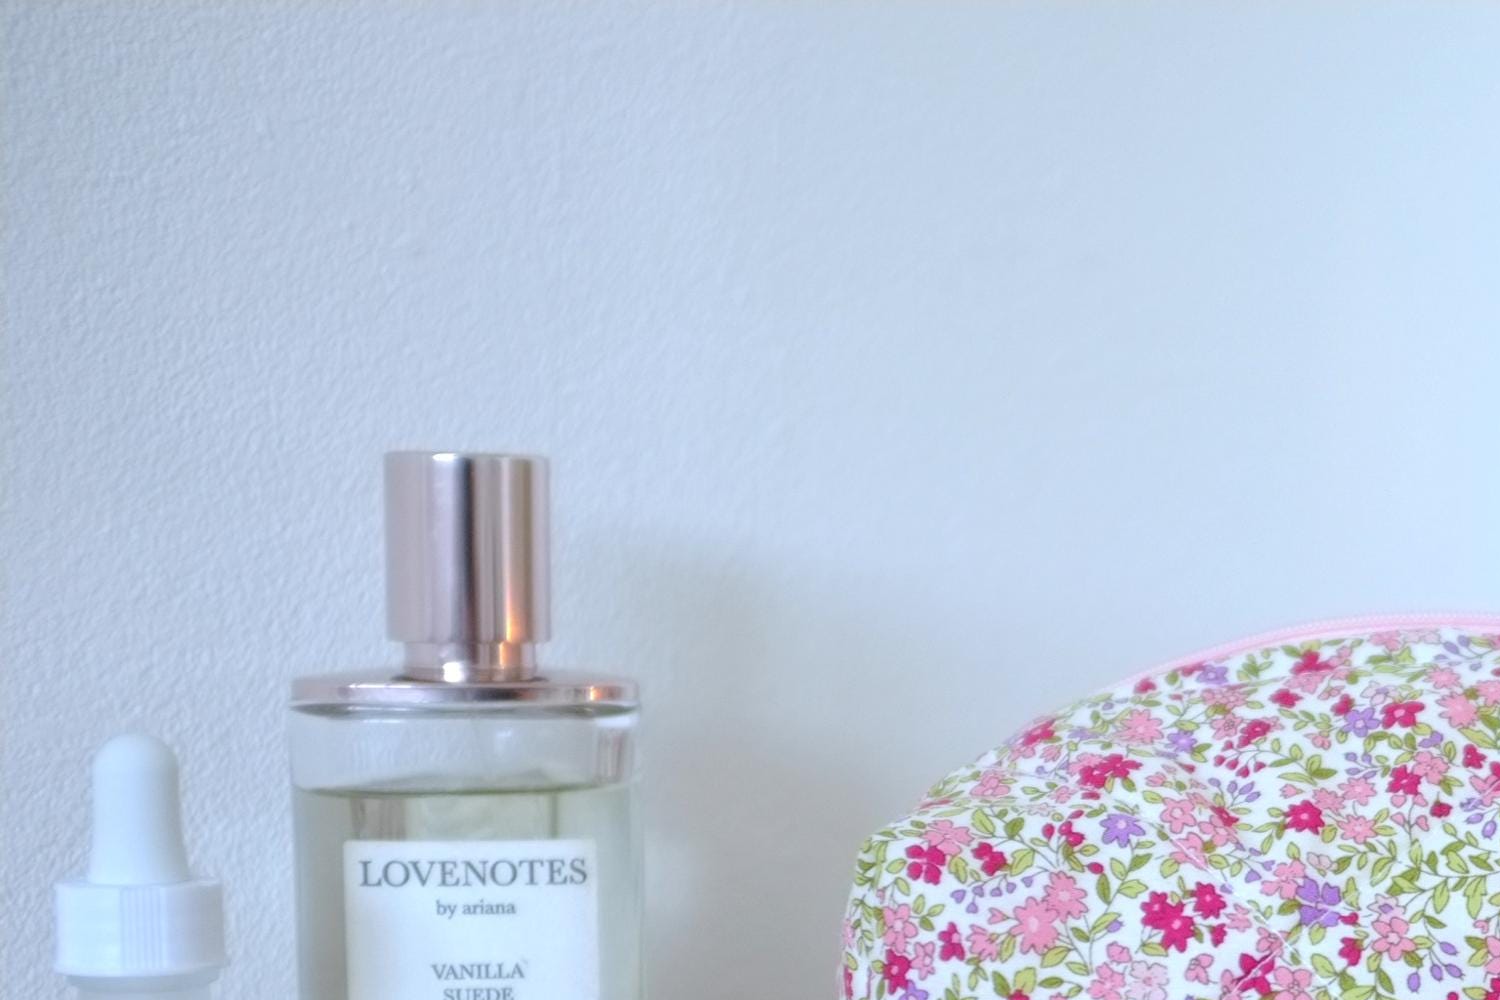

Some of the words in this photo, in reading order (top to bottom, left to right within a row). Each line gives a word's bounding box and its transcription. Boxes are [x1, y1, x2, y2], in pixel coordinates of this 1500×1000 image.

[358, 858, 588, 887] LOVENOTES
[435, 899, 457, 919] by
[462, 899, 517, 916] ariana
[431, 962, 525, 981] VANILLA
